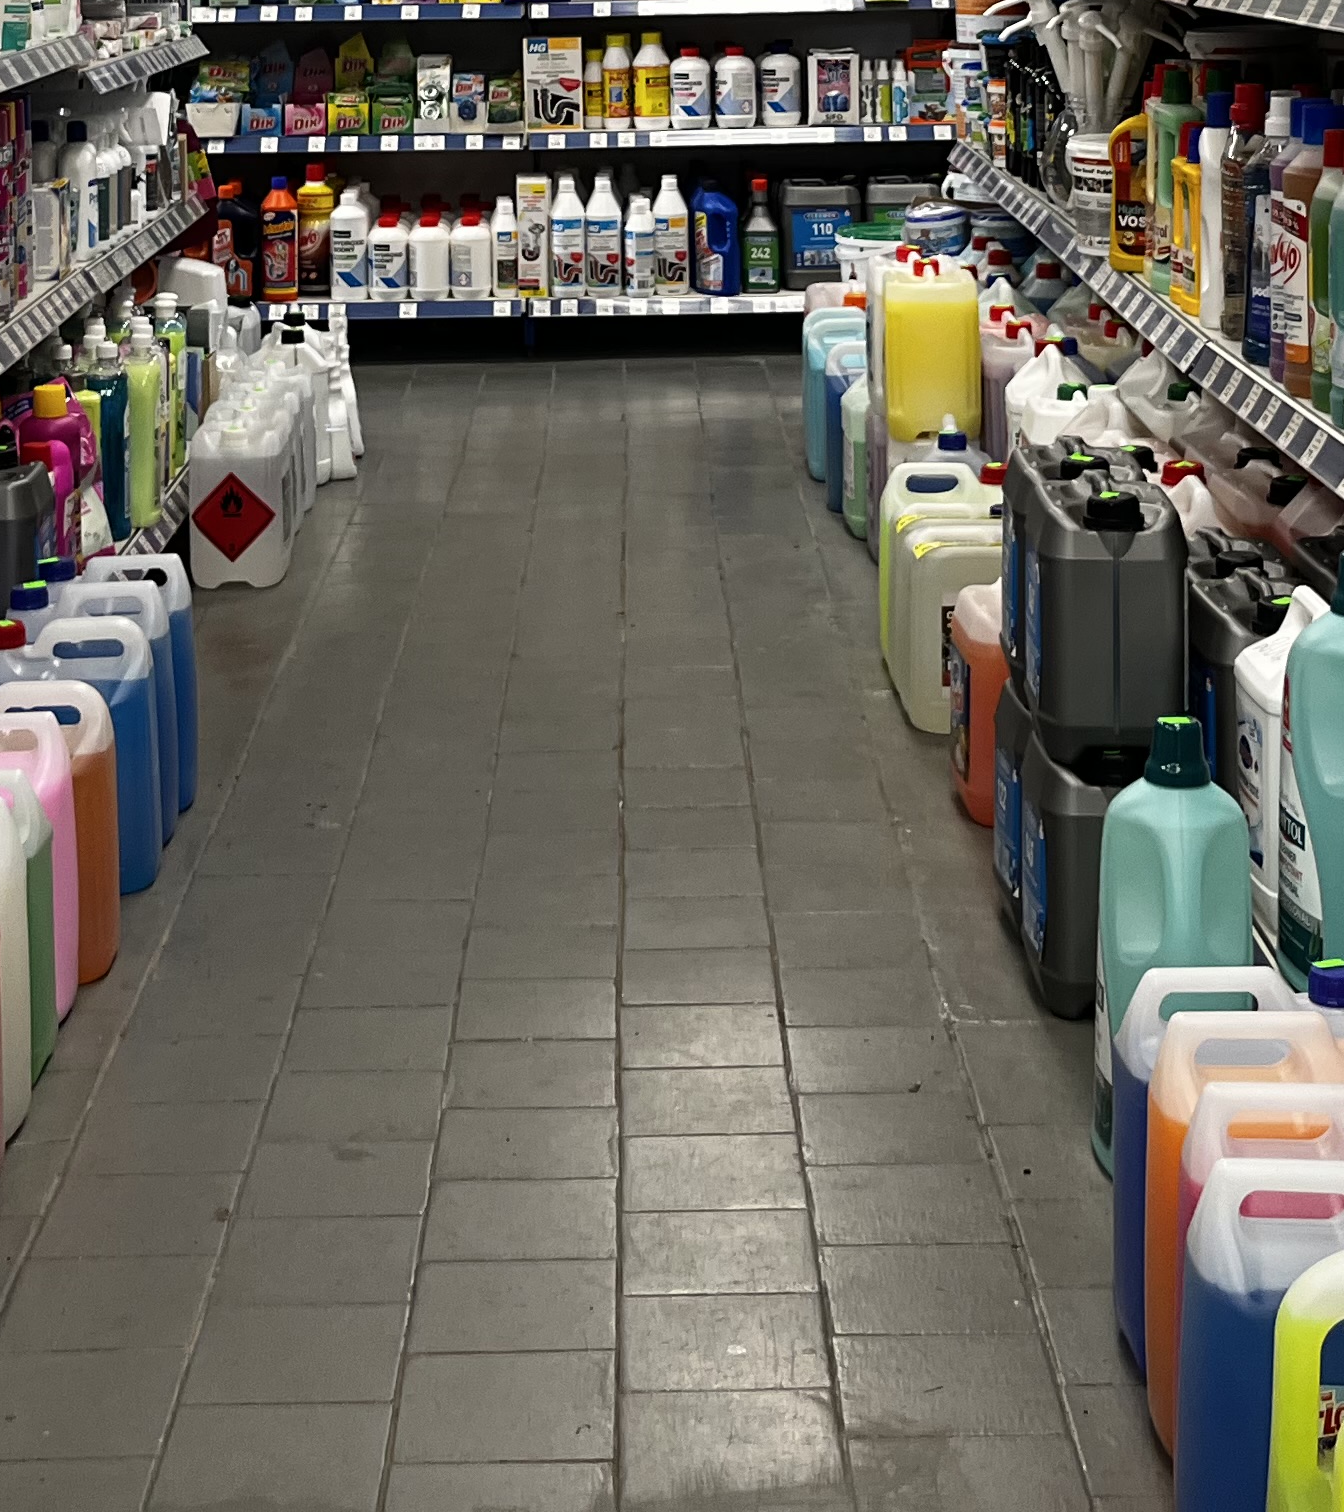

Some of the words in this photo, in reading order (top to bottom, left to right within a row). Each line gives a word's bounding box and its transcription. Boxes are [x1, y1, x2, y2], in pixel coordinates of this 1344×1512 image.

[529, 42, 548, 54] HG
[812, 222, 834, 236] 110
[750, 247, 771, 259] 242
